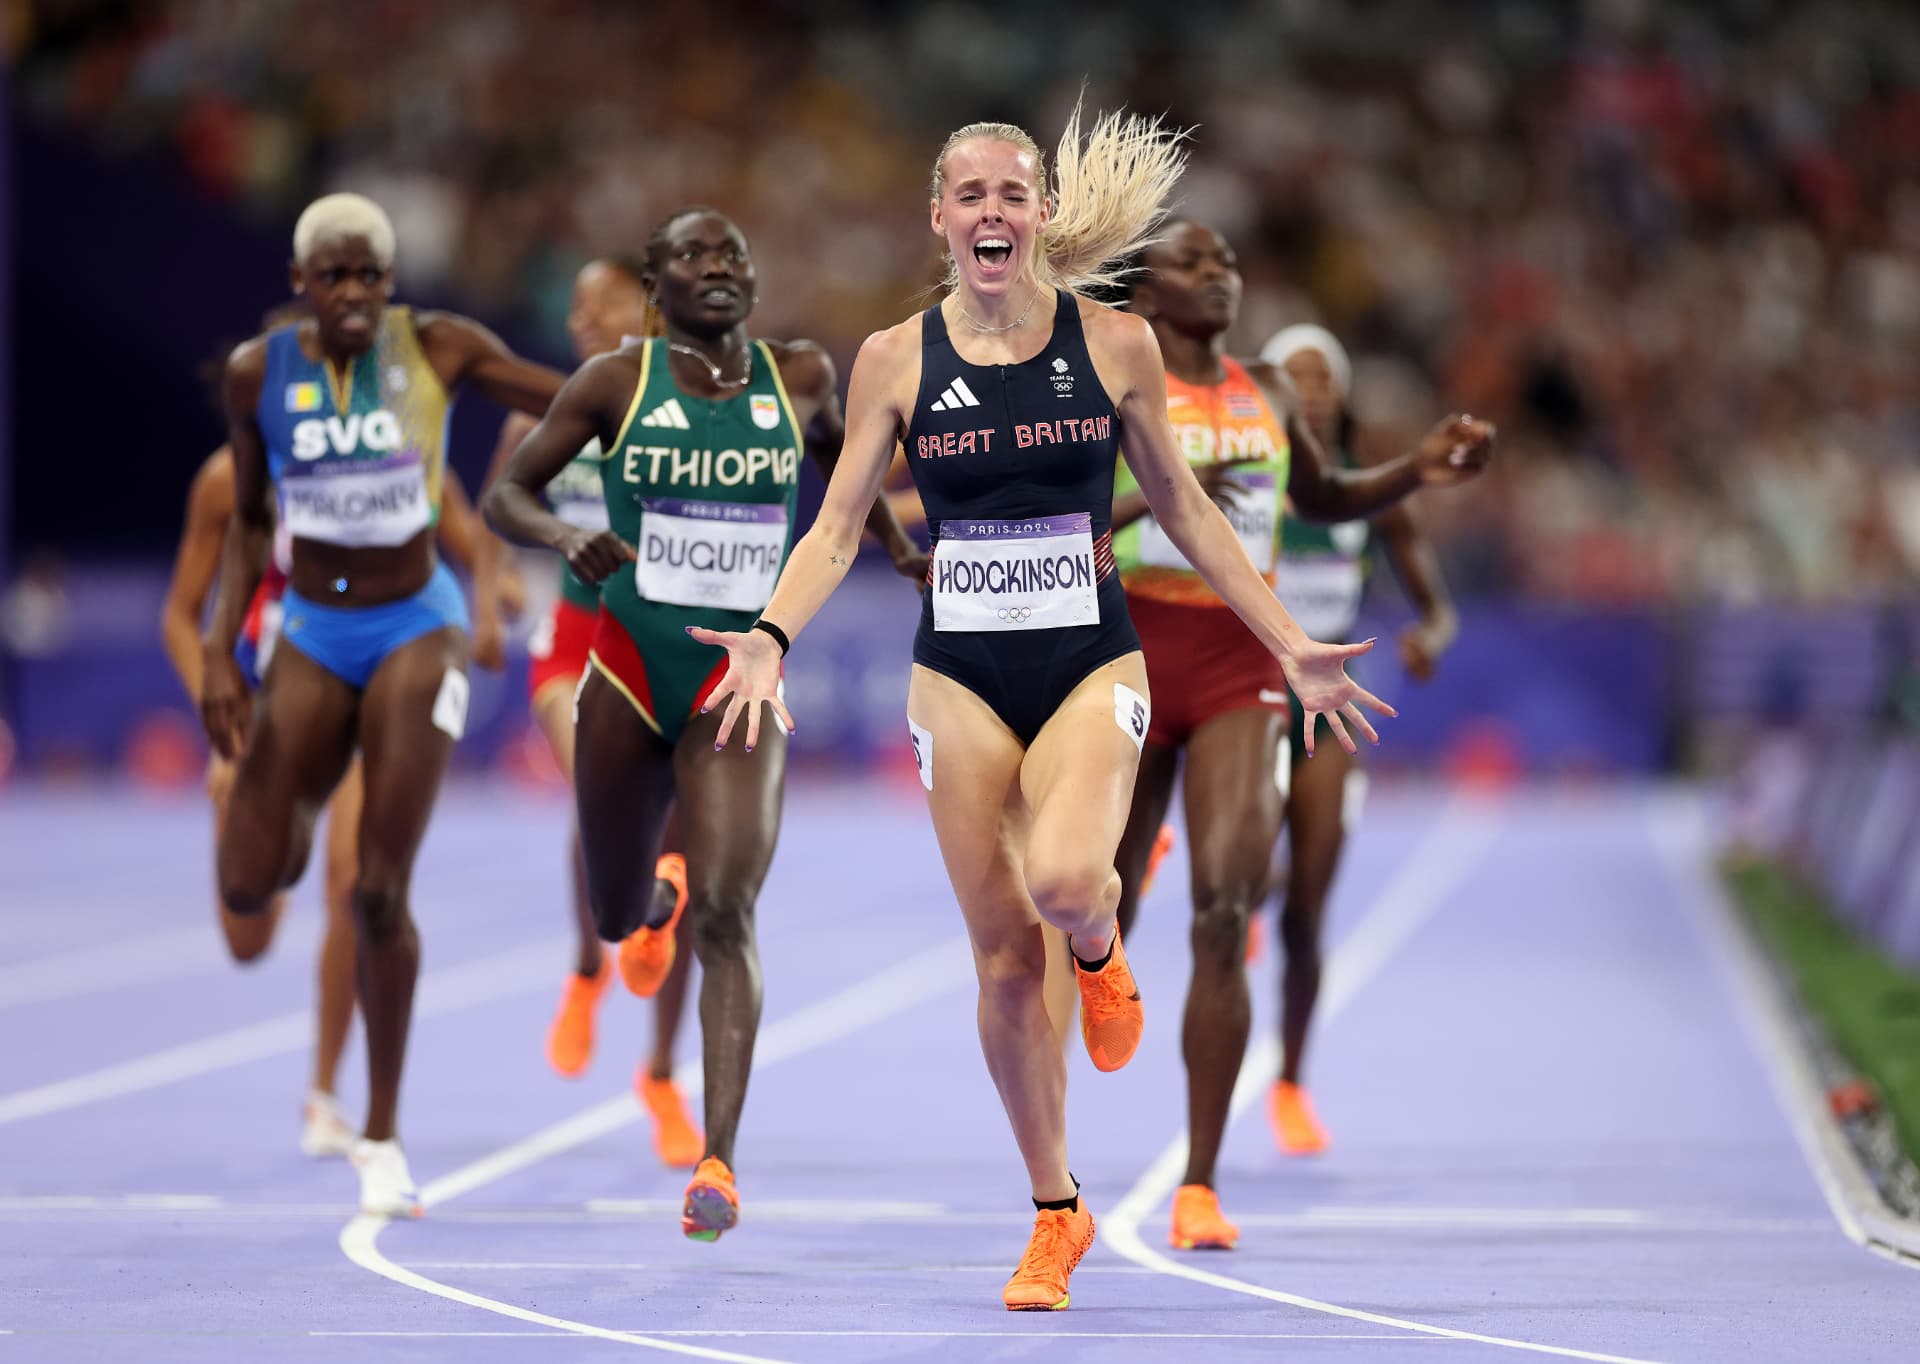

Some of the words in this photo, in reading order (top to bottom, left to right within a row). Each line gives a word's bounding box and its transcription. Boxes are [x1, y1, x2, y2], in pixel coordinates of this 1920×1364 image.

[292, 410, 402, 462] SVG
[917, 428, 996, 460] GREAT
[1014, 414, 1112, 449] BRITAIN
[623, 445, 797, 487] ETHIOPIA
[969, 525, 1010, 536] PARIS
[1015, 523, 1051, 534] 2024
[647, 534, 780, 575] DUGUMA
[938, 553, 1092, 594] HODGKINSON
[1130, 700, 1146, 738] 5
